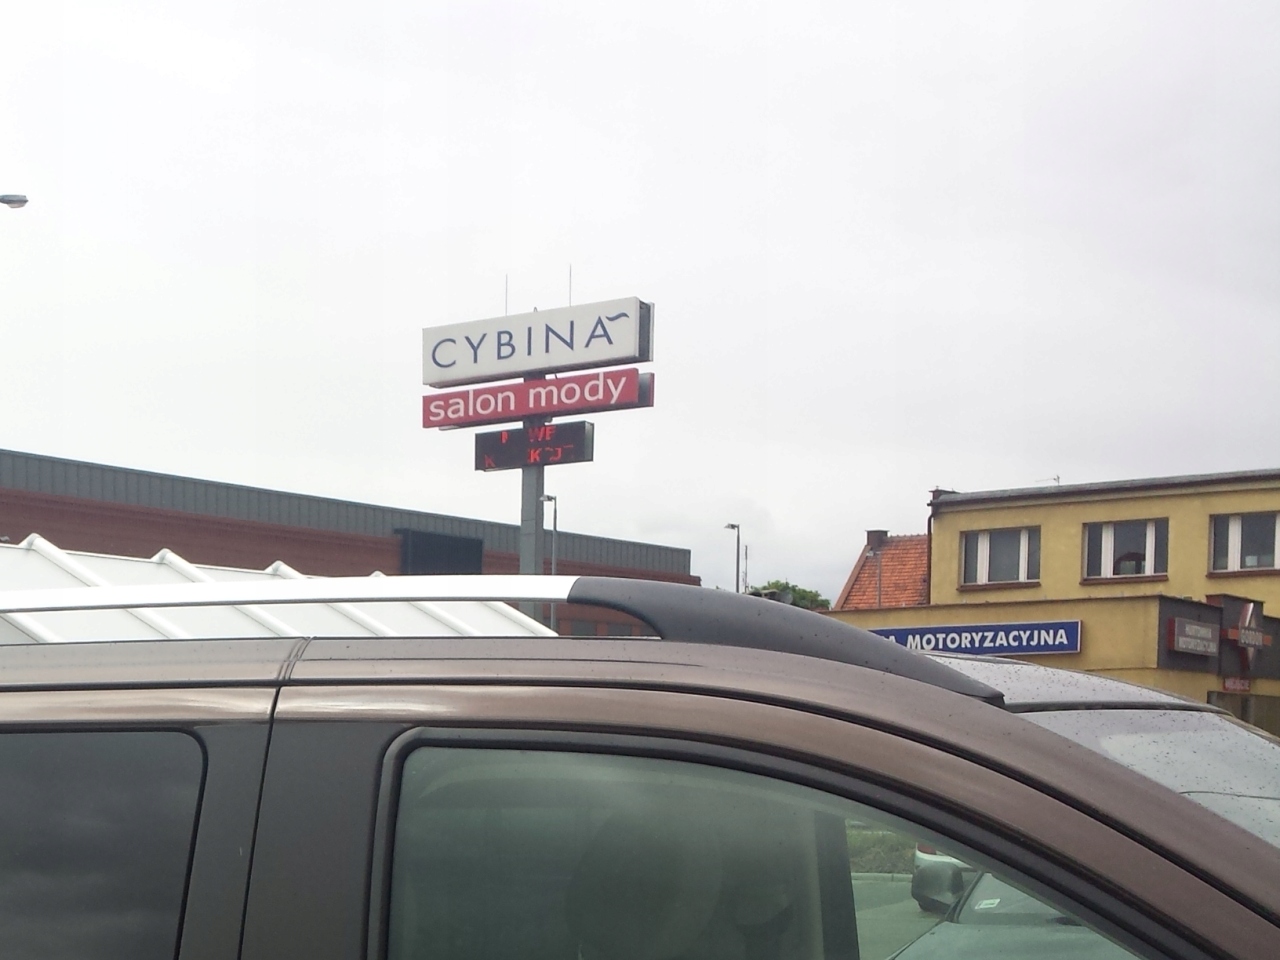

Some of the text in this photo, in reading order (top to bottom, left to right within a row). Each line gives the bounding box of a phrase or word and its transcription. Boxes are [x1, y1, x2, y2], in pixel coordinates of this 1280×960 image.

[431, 316, 618, 368] CYBINA
[429, 372, 627, 421] salon mody
[907, 629, 1068, 650] MOTORYZACYJNA
